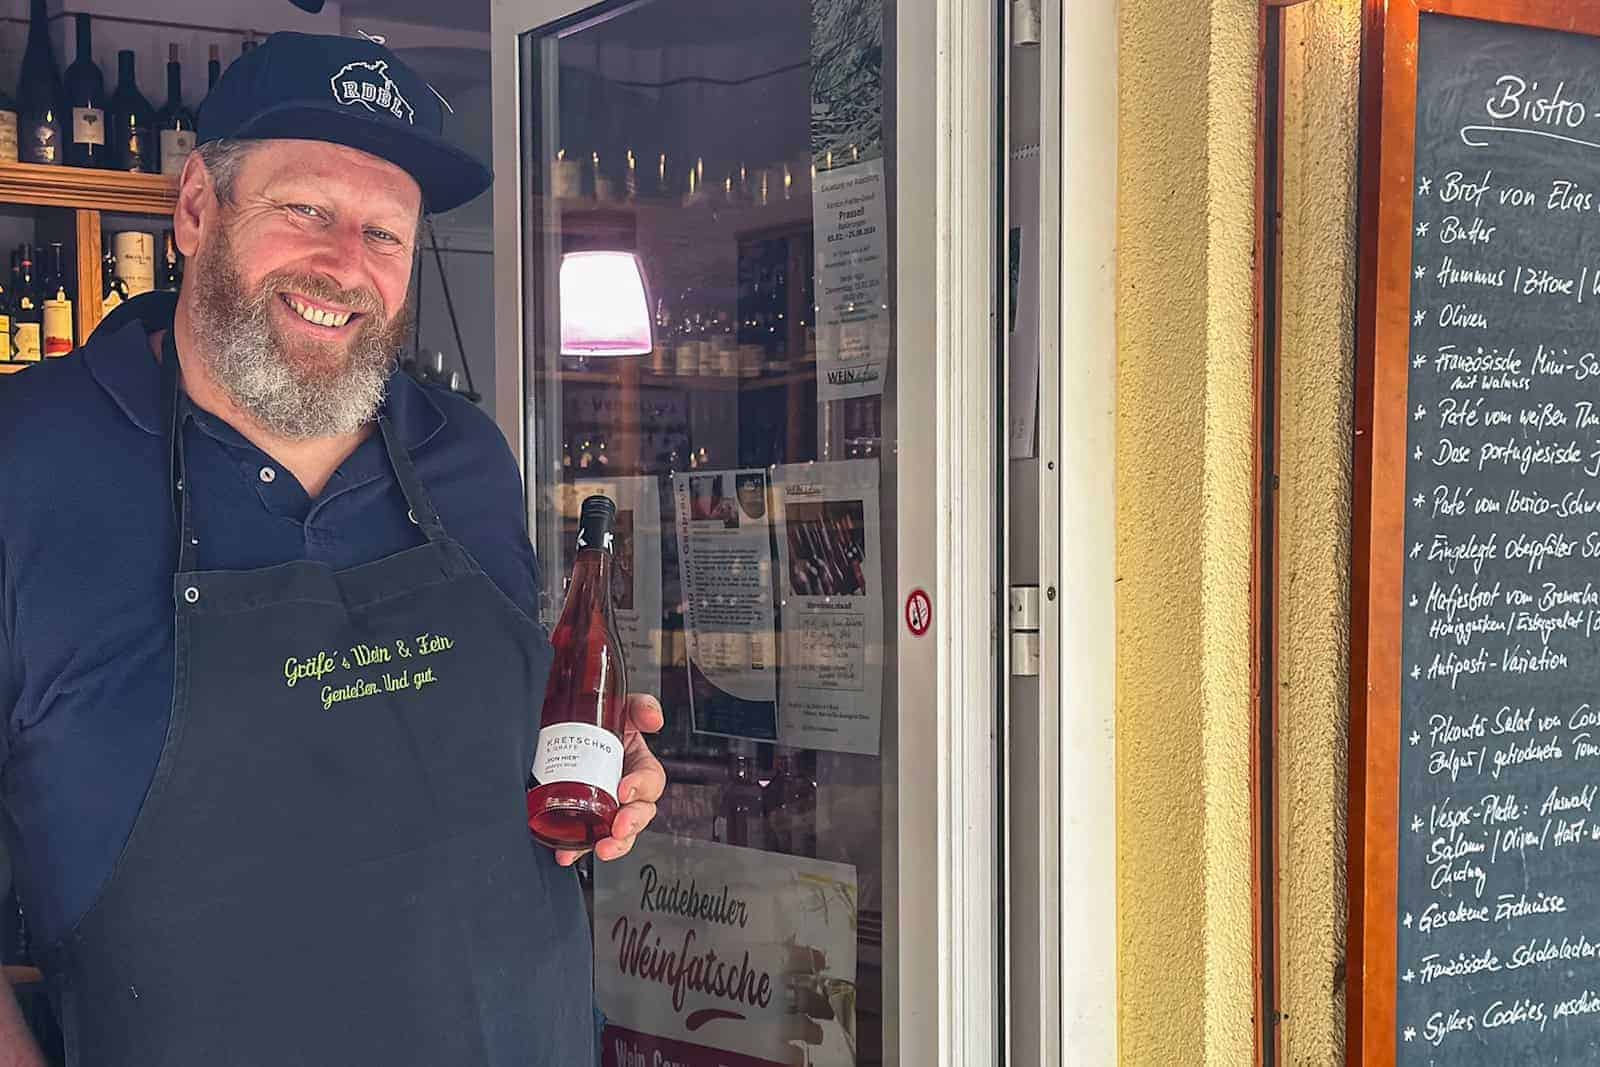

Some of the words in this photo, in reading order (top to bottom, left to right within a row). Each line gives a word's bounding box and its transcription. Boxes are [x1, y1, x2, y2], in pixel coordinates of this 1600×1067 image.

[1440, 170, 1491, 208] Brot
[1500, 186, 1536, 206] von
[1547, 180, 1592, 212] Elias
[1440, 215, 1496, 245] Butter
[1437, 255, 1506, 288] Hummus
[1439, 303, 1488, 328] Oliven
[1450, 374, 1477, 390] mit
[1432, 438, 1472, 466] Dose
[350, 644, 391, 667] Wein
[396, 639, 412, 658] &
[1490, 706, 1536, 735] Salat
[546, 736, 612, 754] KRETSCHKO
[640, 864, 748, 928] Radebeuler
[611, 915, 772, 1012] Weinfatsche
